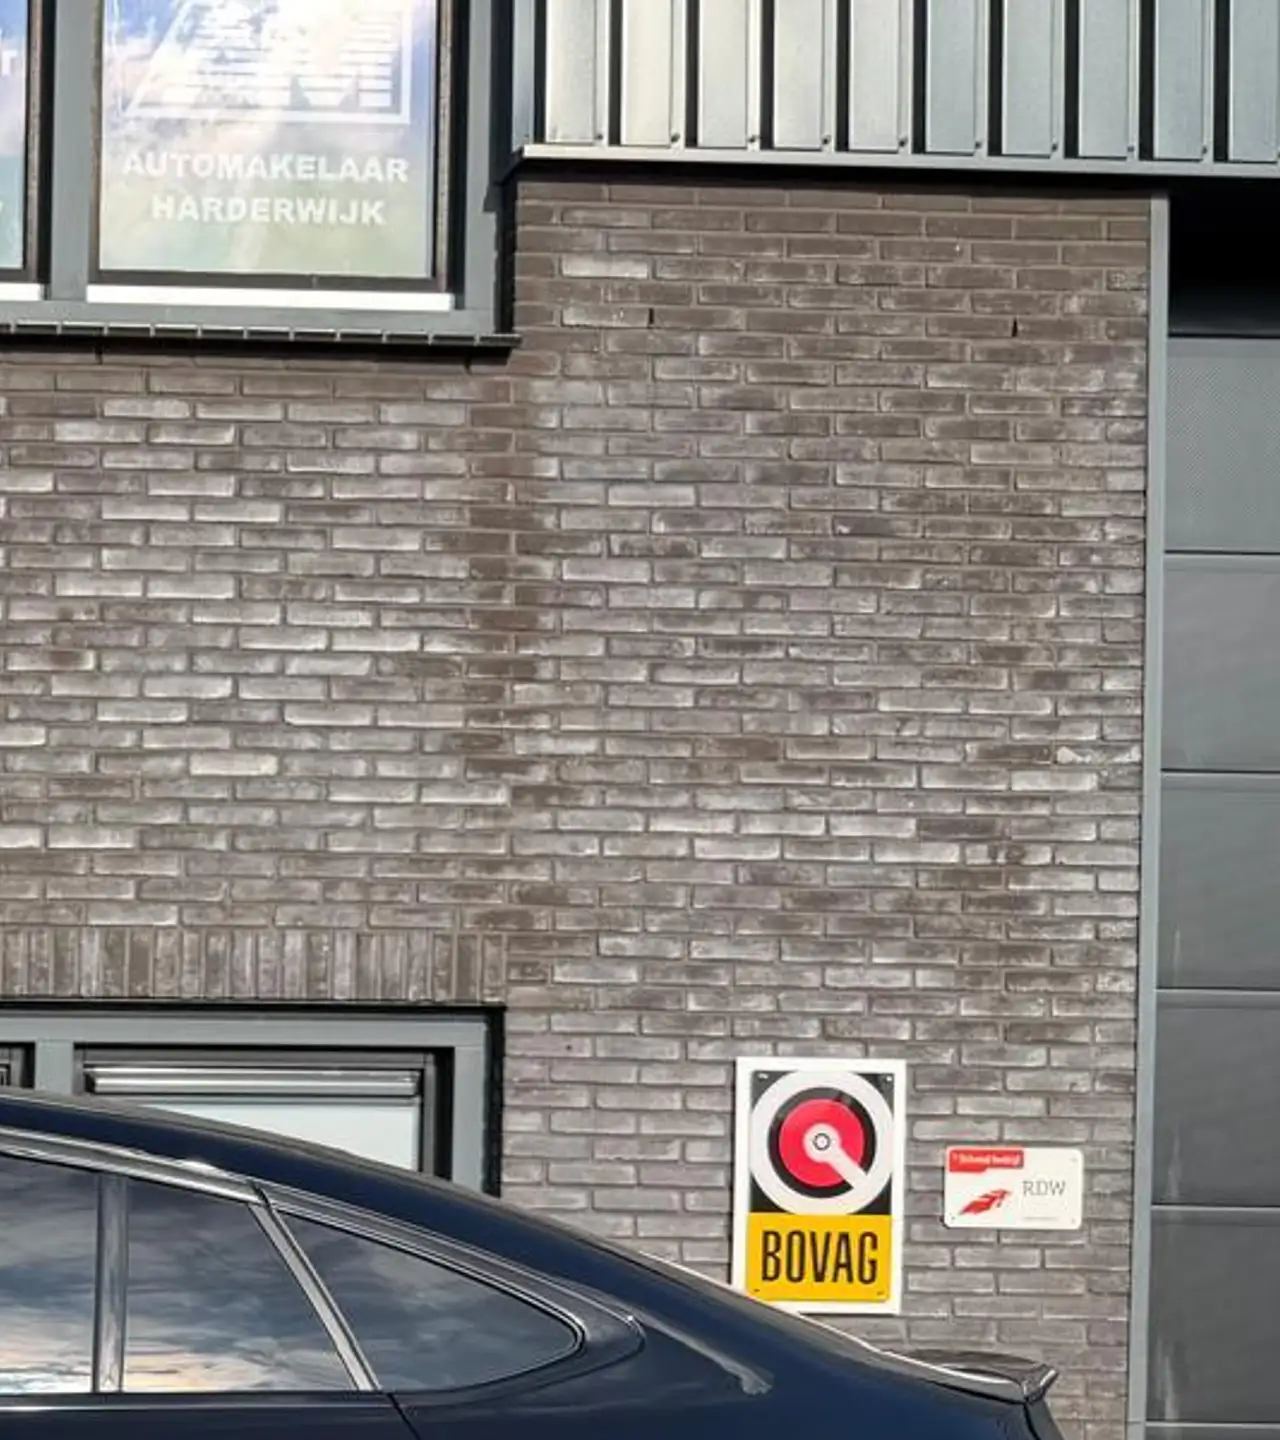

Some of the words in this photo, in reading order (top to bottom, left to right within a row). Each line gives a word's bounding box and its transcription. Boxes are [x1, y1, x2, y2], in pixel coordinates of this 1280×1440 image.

[123, 152, 410, 183] AUTOMAKELAAR
[151, 196, 388, 225] HARDERWIJK
[1022, 1180, 1066, 1197] RDW
[761, 1230, 878, 1285] BOVAG
